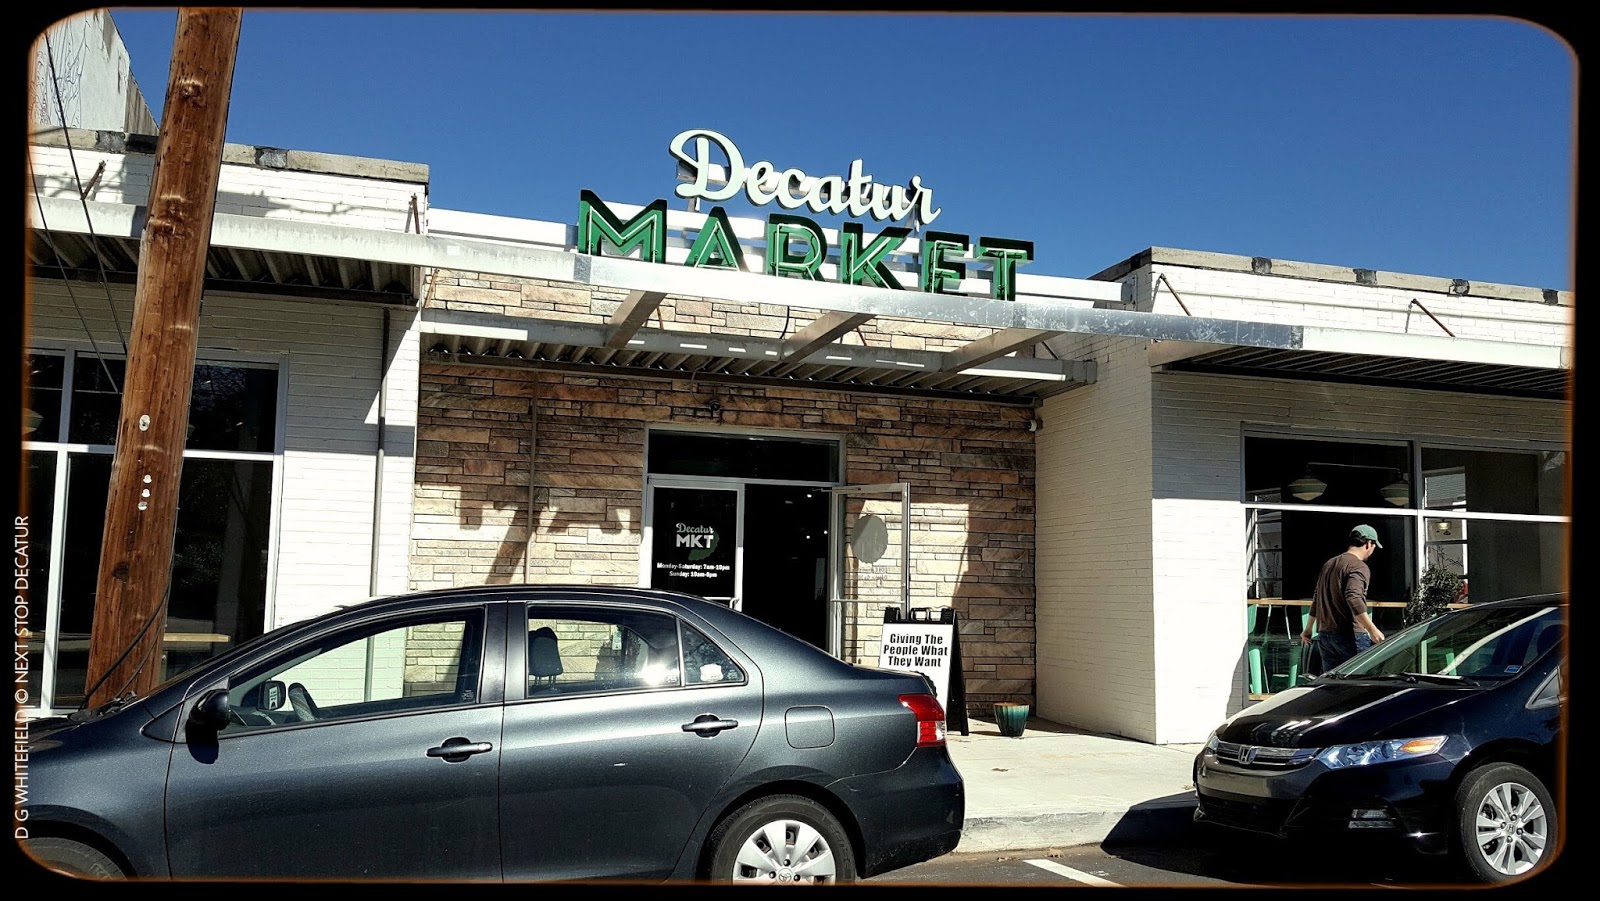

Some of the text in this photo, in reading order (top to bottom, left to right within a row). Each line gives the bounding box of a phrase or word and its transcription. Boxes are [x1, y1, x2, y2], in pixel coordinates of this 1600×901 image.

[668, 128, 941, 226] Decatur
[578, 189, 1034, 302] MARKET
[676, 522, 714, 534] Decatur
[676, 533, 714, 548] MKT
[669, 570, 690, 578] Sunday:
[890, 633, 943, 645] Giving The
[883, 644, 948, 656] People What
[888, 656, 941, 667] They Want
